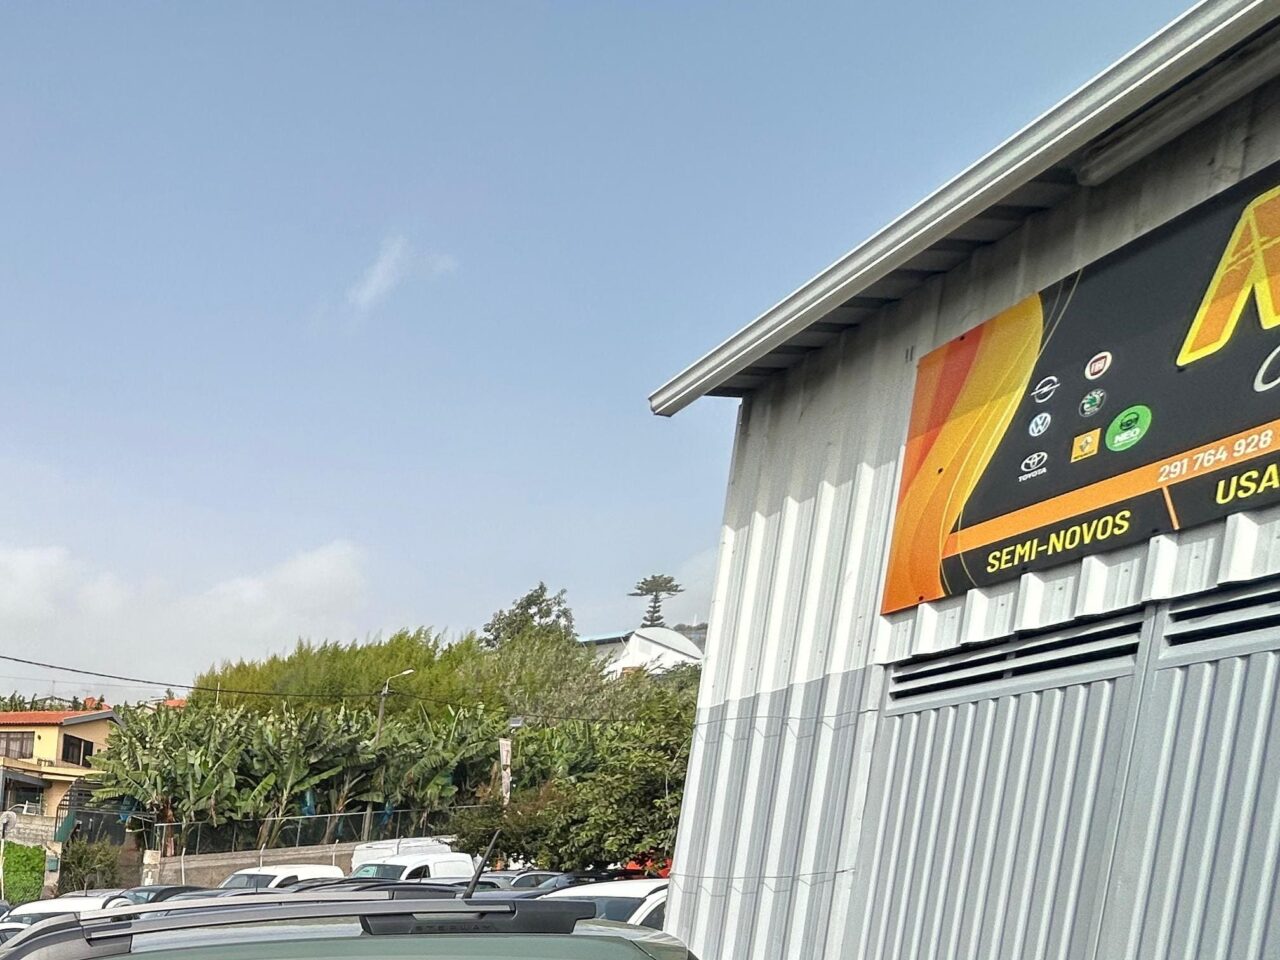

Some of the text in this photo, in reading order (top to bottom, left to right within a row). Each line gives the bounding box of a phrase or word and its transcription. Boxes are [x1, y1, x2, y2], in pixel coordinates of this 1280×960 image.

[1018, 467, 1047, 483] TOYOTA
[1157, 429, 1273, 483] 291 764 928
[1216, 463, 1280, 505] USA
[986, 510, 1131, 573] SEMI-NOVOS
